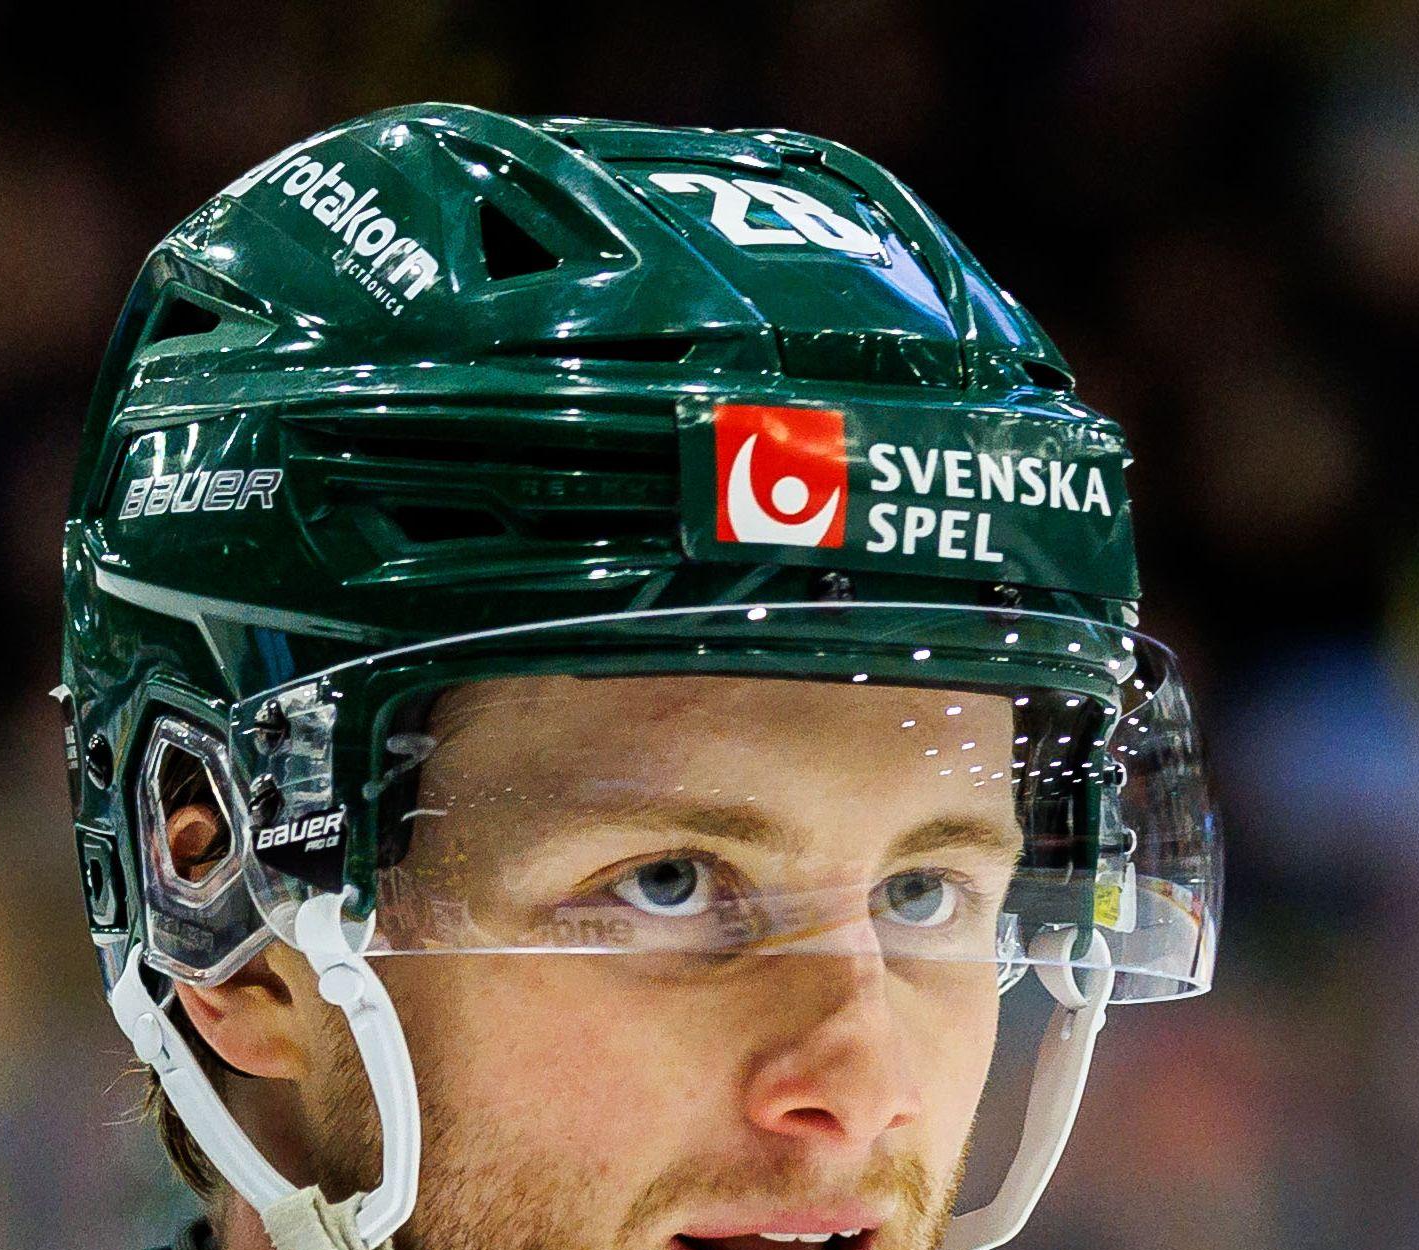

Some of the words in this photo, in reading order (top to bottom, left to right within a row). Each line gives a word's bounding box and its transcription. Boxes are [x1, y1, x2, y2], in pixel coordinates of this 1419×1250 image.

[266, 155, 440, 301] rotakorn
[118, 468, 284, 521] BAUER
[868, 442, 1112, 517] SVENSKA
[865, 502, 1004, 563] SPEL
[256, 811, 345, 850] BAUER
